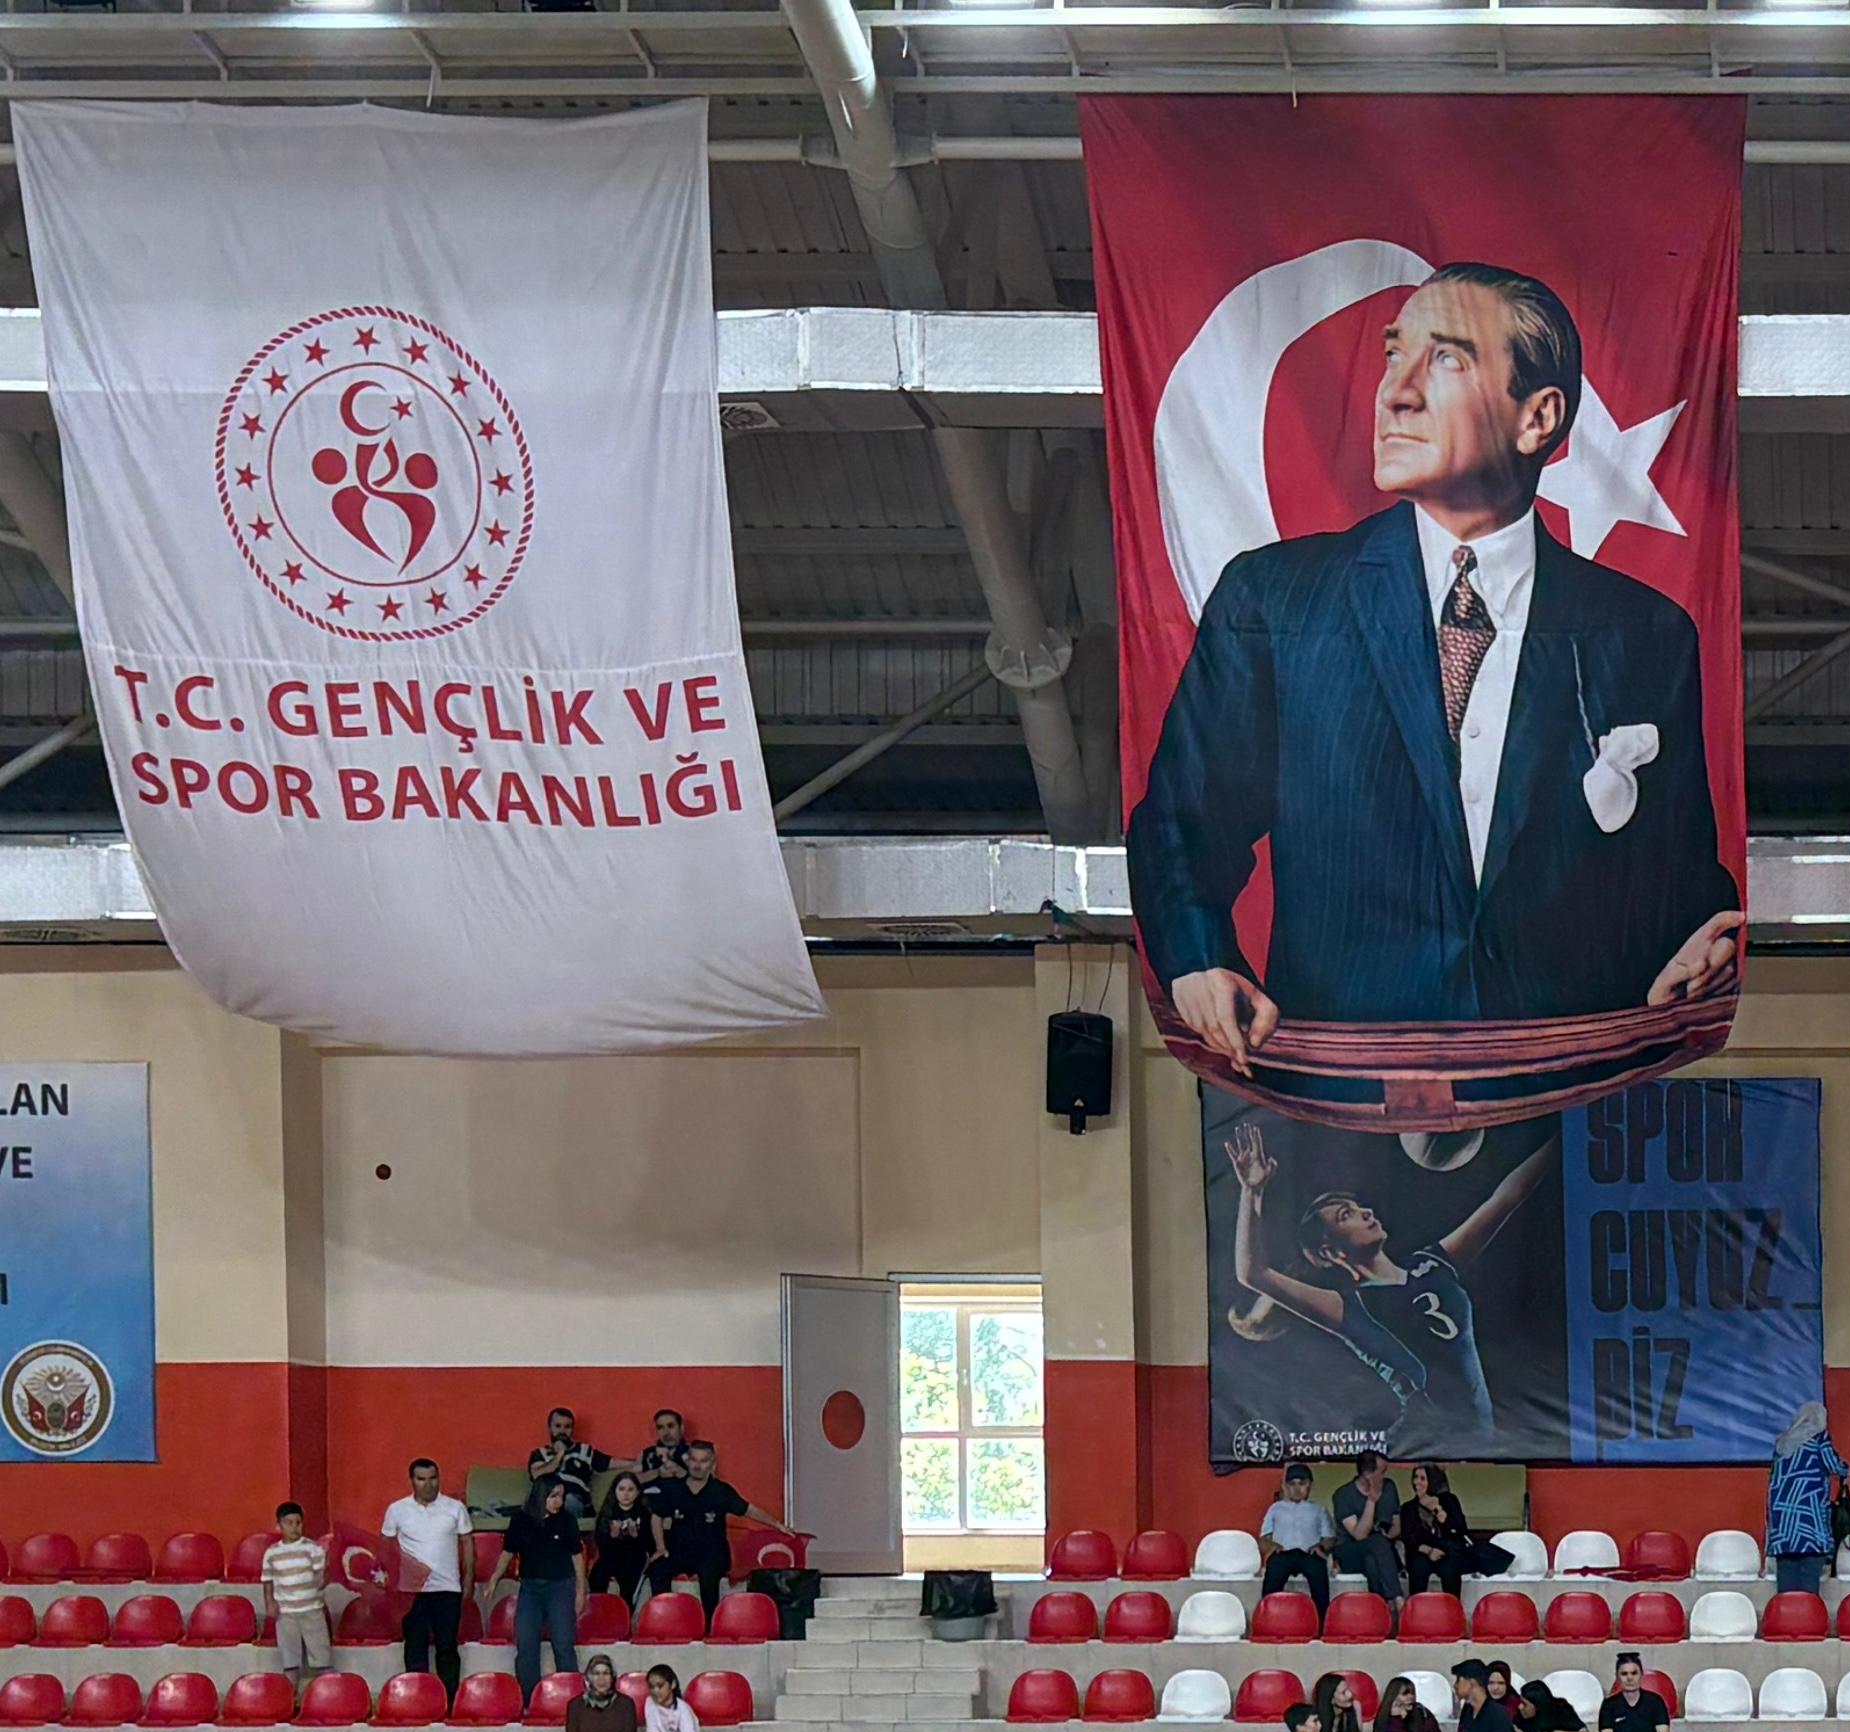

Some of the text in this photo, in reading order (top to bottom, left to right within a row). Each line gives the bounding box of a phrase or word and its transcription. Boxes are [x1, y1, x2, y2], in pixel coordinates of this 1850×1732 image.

[114, 665, 726, 753] T.C. GENÇLİK VE
[130, 751, 743, 828] SPOR BAKANLIĞI
[1587, 1080, 1744, 1185] SPOR
[1590, 1208, 1782, 1313] CUYUZ
[1412, 1291, 1458, 1341] 3
[1593, 1327, 1694, 1441] BİZ
[1313, 1430, 1368, 1444] GENÇLİK
